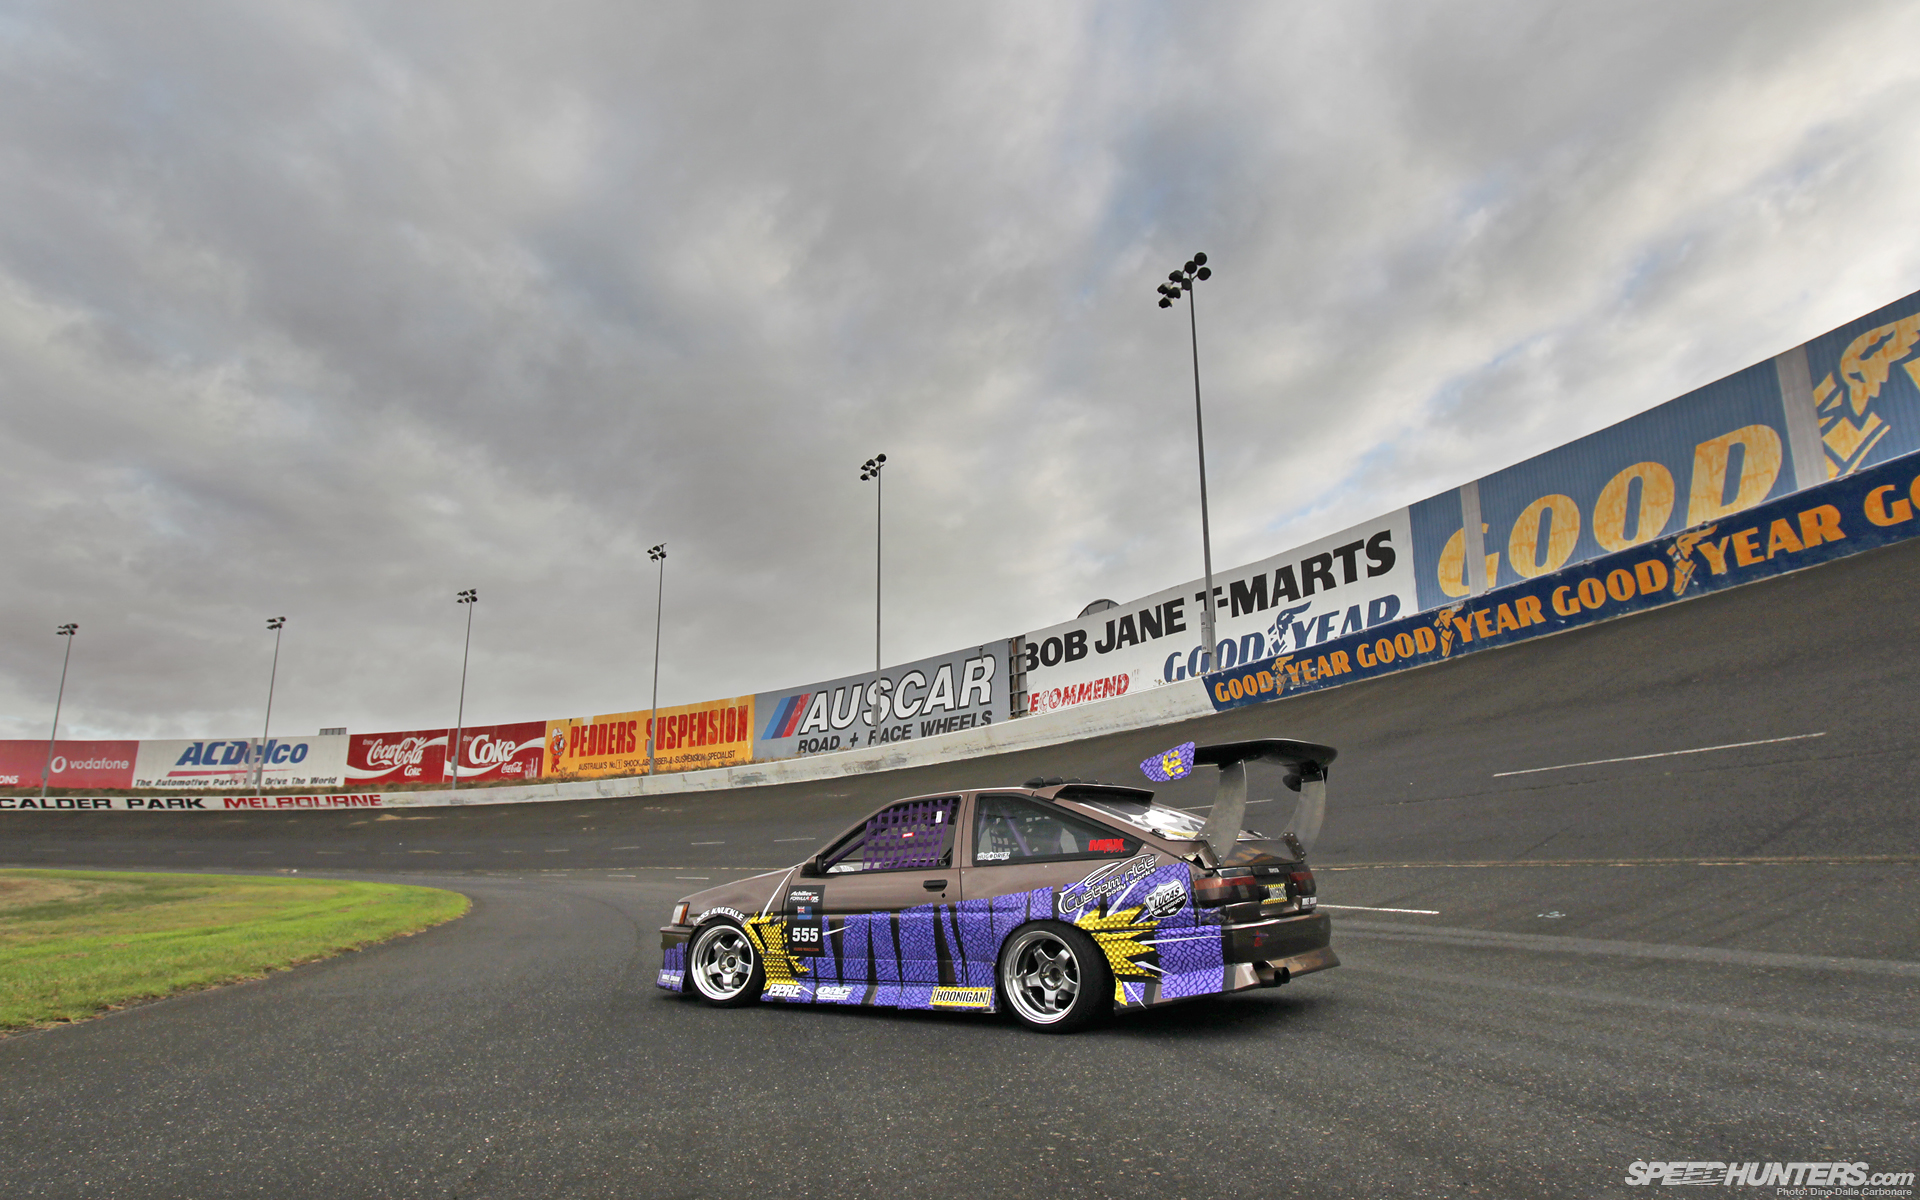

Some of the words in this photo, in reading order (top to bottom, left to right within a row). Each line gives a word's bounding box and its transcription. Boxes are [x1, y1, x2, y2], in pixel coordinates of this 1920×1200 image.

[1438, 424, 1783, 598] GOOD
[1026, 629, 1088, 672] BOB
[1094, 597, 1187, 654] JANE
[1195, 529, 1397, 623] T-MARTS
[1356, 629, 1437, 671] GOOD
[1454, 595, 1544, 643] YEAR
[1553, 557, 1668, 617] GOOD
[1695, 504, 1847, 568] YEAR
[798, 654, 996, 736] AUSCAR
[1027, 672, 1130, 713] ECOMMEND
[569, 719, 637, 758] PEDDERS
[798, 735, 840, 754] ROAD
[868, 723, 913, 746] RACE
[921, 710, 992, 738] WHEELS
[70, 757, 130, 770] vodafone
[175, 739, 309, 766] ACDelco
[468, 734, 516, 765] Coke
[579, 761, 608, 771] AUSTRALIA'S
[624, 759, 640, 768] SHOCK
[643, 756, 668, 767] ABSRBER
[707, 750, 735, 761] SPECIALIST
[135, 778, 152, 787] The
[155, 778, 209, 787] Automotive
[213, 778, 239, 786] Parts
[265, 777, 288, 785] Drive
[292, 777, 305, 785] The
[310, 776, 337, 785] World
[404, 765, 422, 777] Coke
[0, 798, 112, 809] CALDER
[126, 798, 207, 809] PARK
[223, 794, 382, 810] MELBOURNE
[1063, 875, 1122, 913] Custom
[1124, 855, 1156, 881] ride
[1106, 883, 1127, 897] body
[1129, 867, 1156, 885] works
[1154, 887, 1180, 908] LUCAS
[1162, 895, 1186, 911] PRODUCTS
[792, 927, 819, 942] 555
